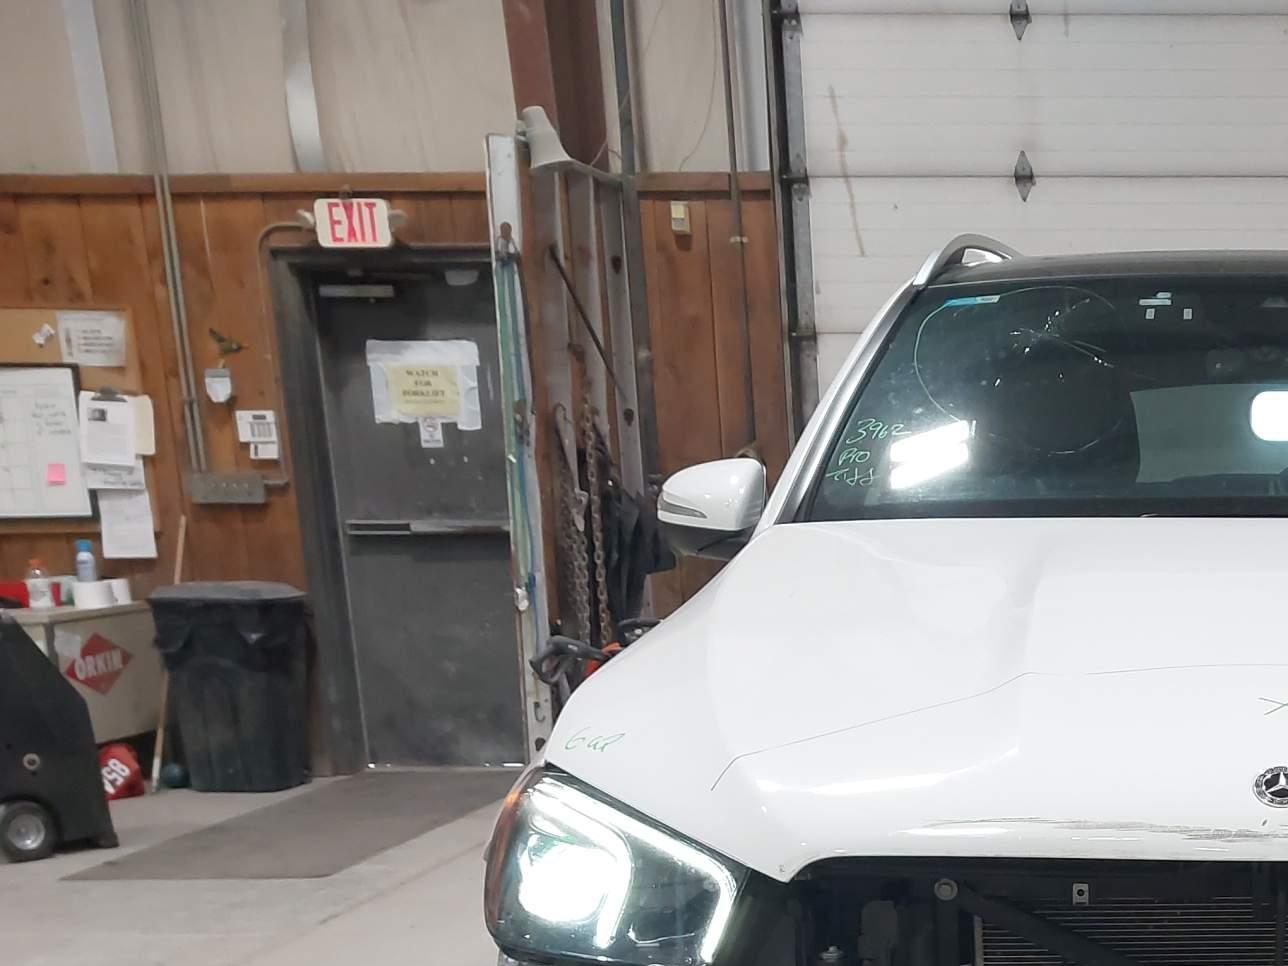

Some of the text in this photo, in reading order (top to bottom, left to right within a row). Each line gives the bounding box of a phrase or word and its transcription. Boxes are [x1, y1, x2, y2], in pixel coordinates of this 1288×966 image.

[327, 202, 377, 242] EXIT
[846, 418, 912, 444] 3962
[74, 650, 122, 680] ORKIN
